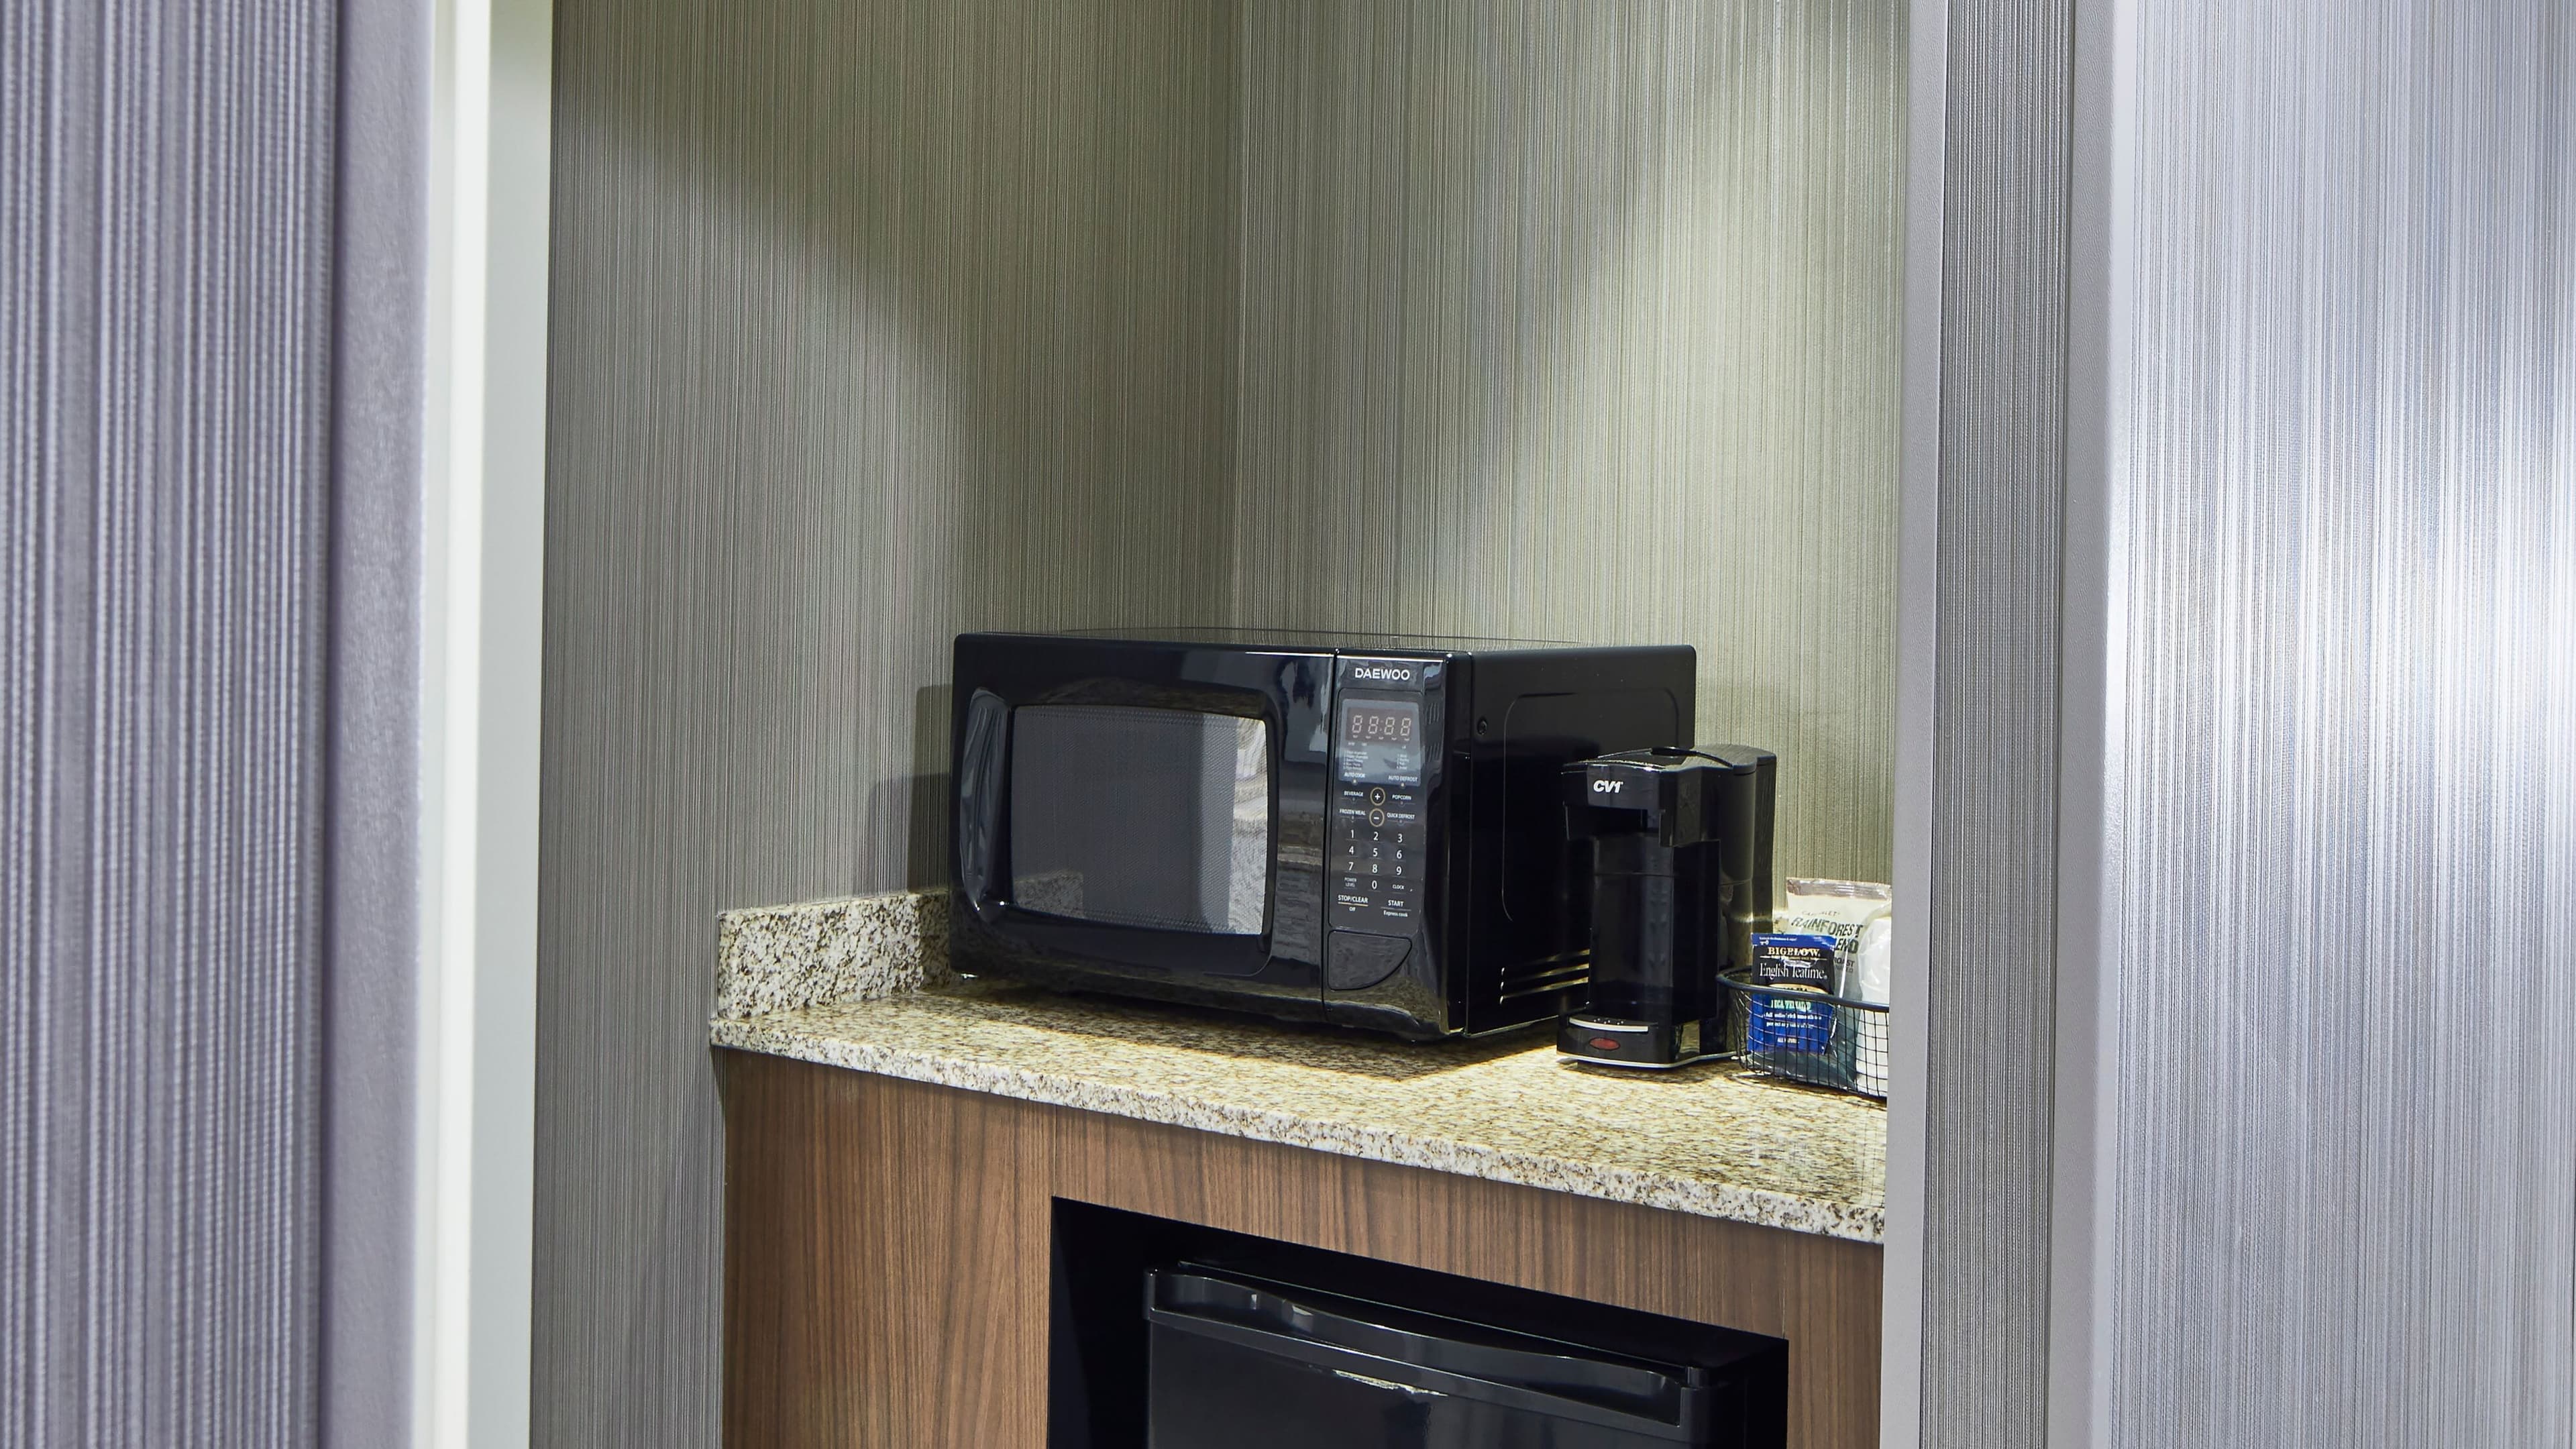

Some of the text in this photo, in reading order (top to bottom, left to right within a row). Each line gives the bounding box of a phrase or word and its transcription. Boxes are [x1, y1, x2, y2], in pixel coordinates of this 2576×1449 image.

[1354, 667, 1410, 681] DAEWOO
[1350, 829, 1354, 839] 1
[1373, 831, 1379, 841] 2
[1397, 833, 1403, 843] 3
[1348, 845, 1354, 855] 4
[1373, 848, 1378, 857] 5
[1396, 849, 1402, 859] 6
[1348, 861, 1354, 871] 7
[1372, 863, 1378, 873] 8
[1396, 866, 1402, 875] 9
[1371, 880, 1377, 890] 0
[1338, 894, 1368, 904] STOP/CLEAR
[1388, 900, 1404, 908] START
[1383, 910, 1398, 918] Express
[1791, 917, 1863, 938] RAINFOREST
[1835, 938, 1859, 954] END
[1768, 947, 1819, 957] BIGELOW
[1760, 963, 1789, 980] English
[1791, 964, 1824, 979] Teatime
